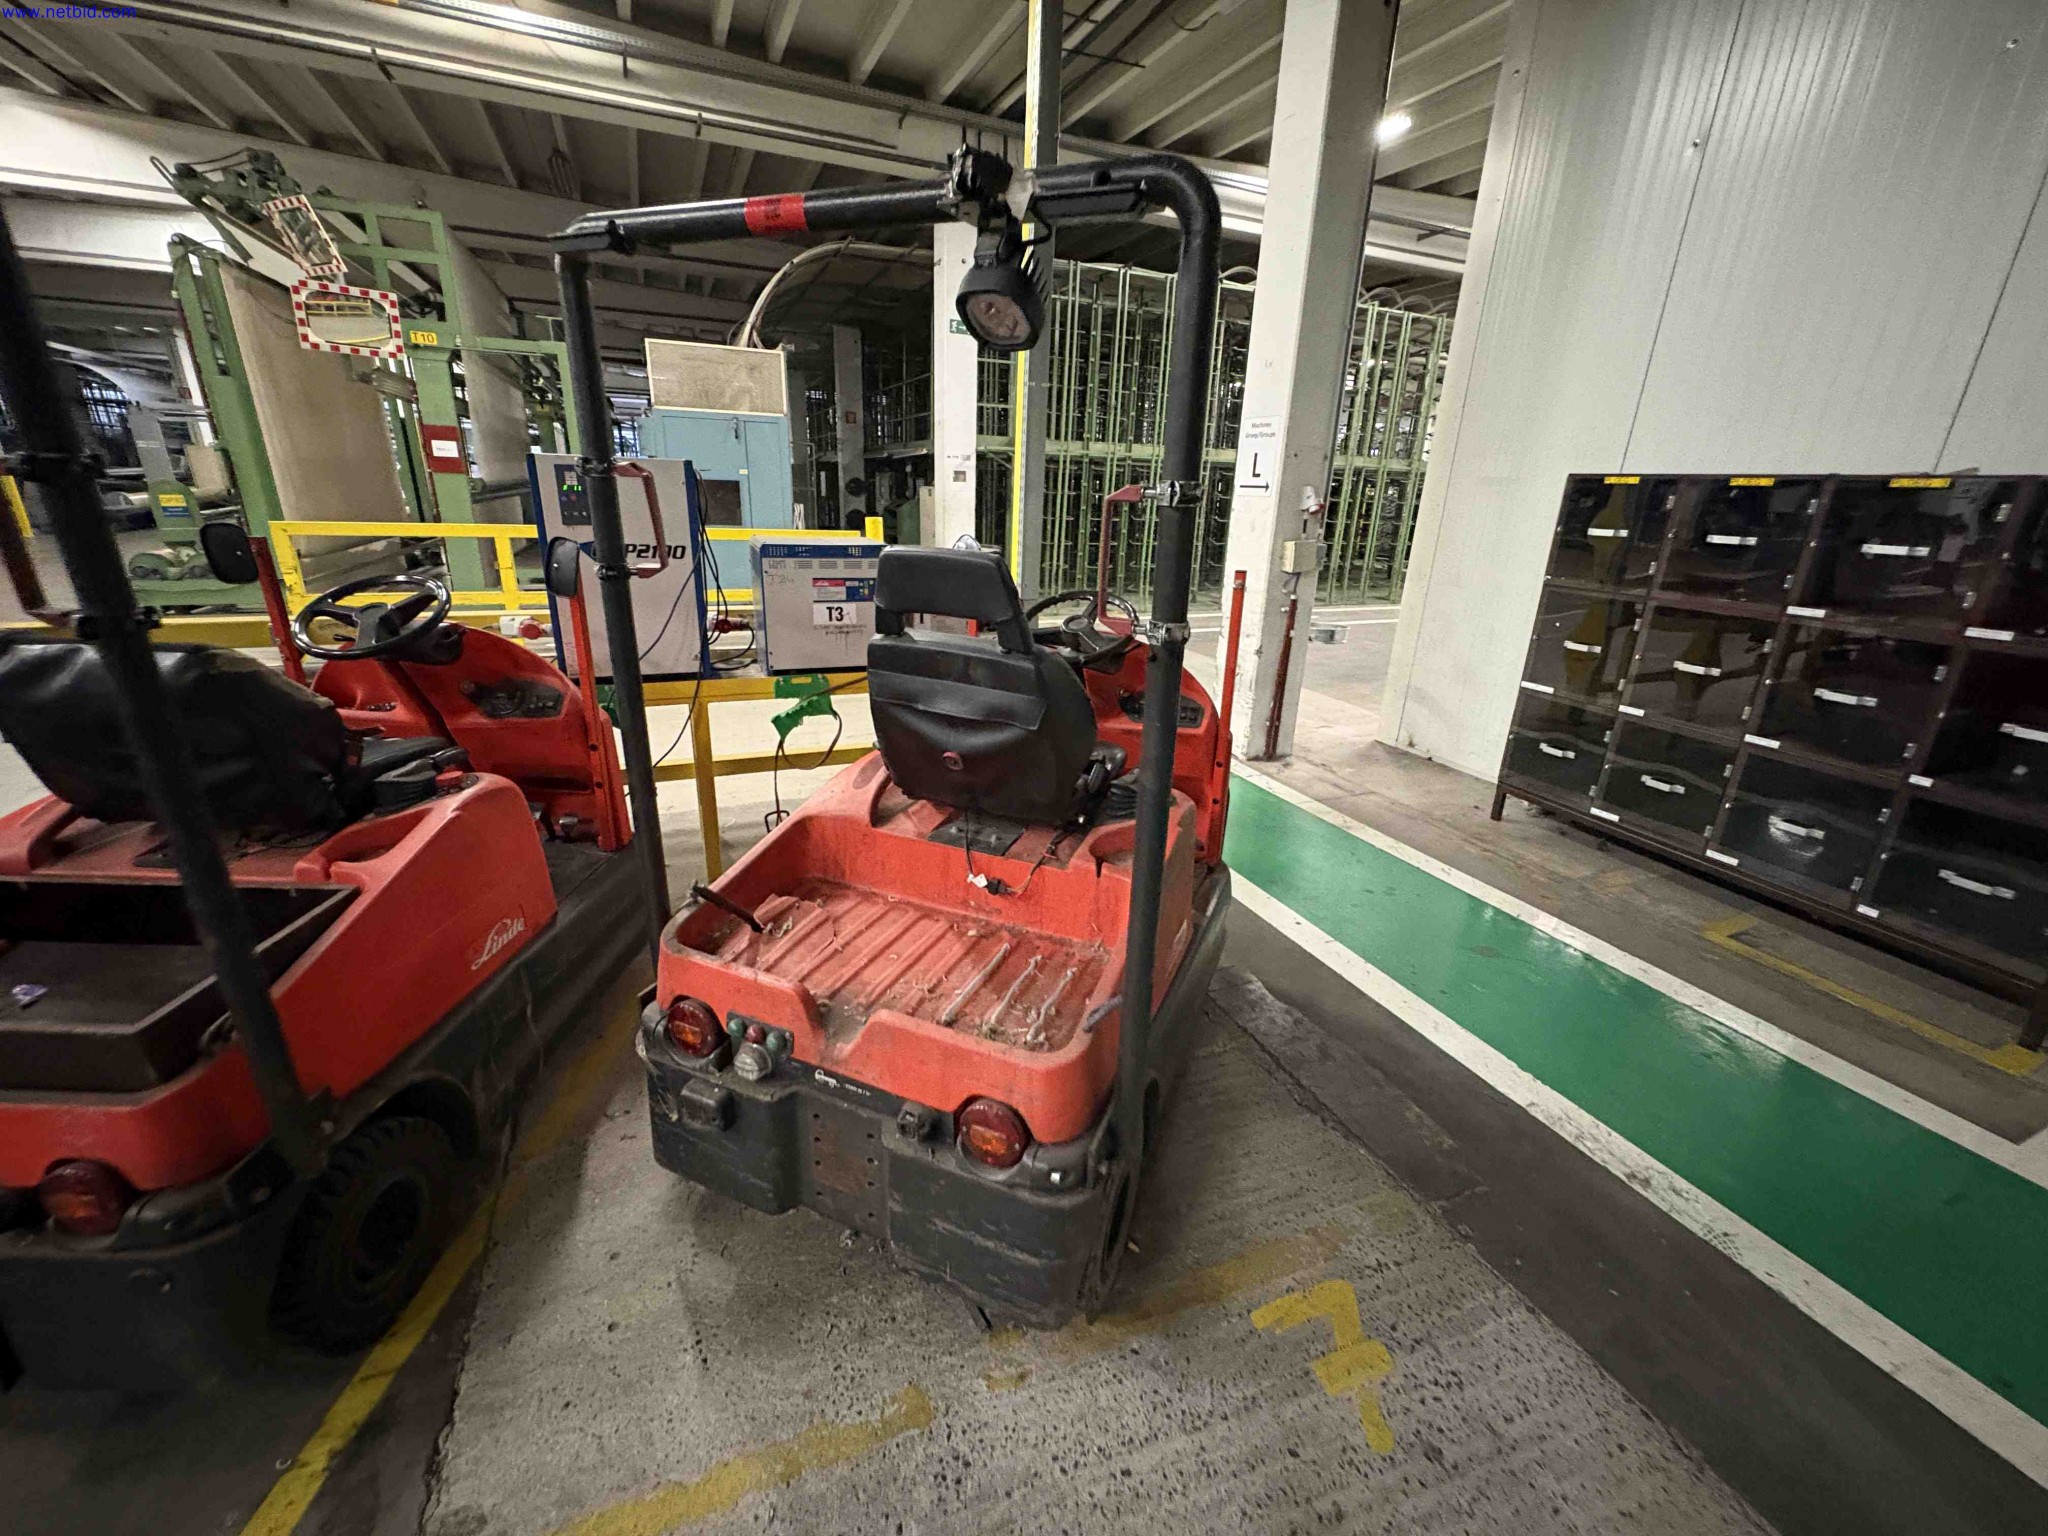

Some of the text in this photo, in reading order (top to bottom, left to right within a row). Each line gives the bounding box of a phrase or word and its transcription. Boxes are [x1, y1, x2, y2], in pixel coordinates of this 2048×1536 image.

[412, 332, 434, 343] T10
[1252, 453, 1261, 477] L
[826, 606, 844, 622] T3
[471, 917, 525, 970] Linde
